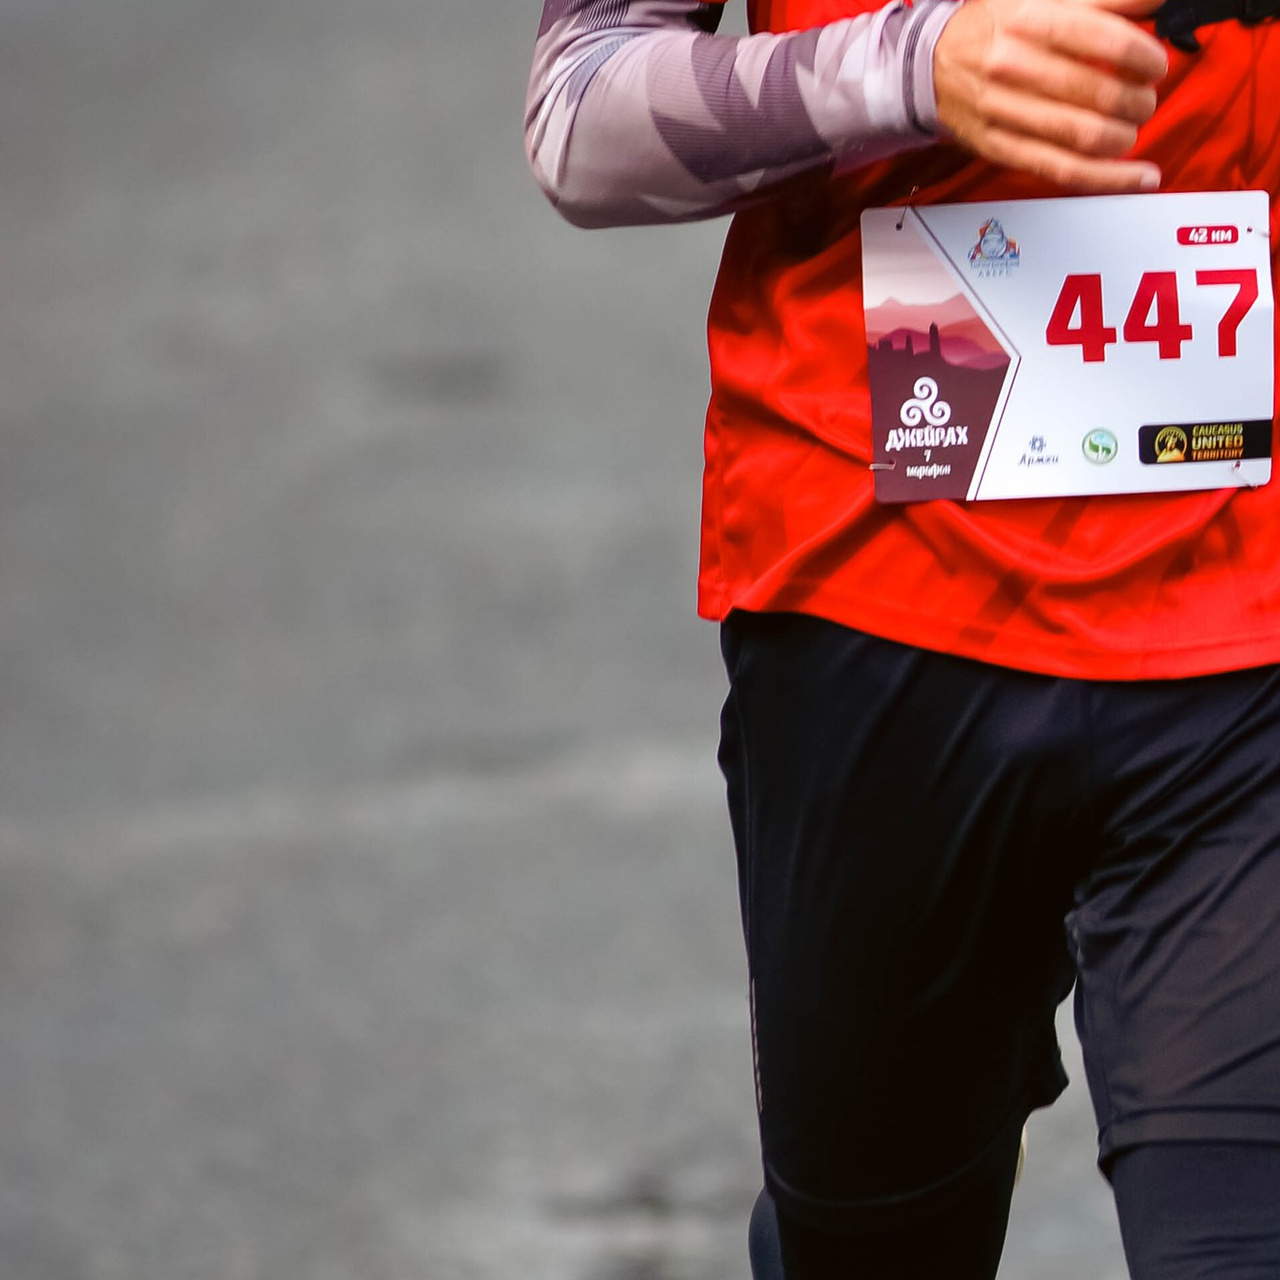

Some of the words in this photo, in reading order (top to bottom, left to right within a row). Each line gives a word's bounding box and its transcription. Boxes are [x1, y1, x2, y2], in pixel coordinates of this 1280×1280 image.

[1189, 227, 1208, 243] 42
[1046, 268, 1258, 362] 447
[1192, 423, 1244, 437] CAUCASUS
[885, 425, 969, 452] ДЖЕЙРАХ
[1192, 435, 1244, 450] UNITED
